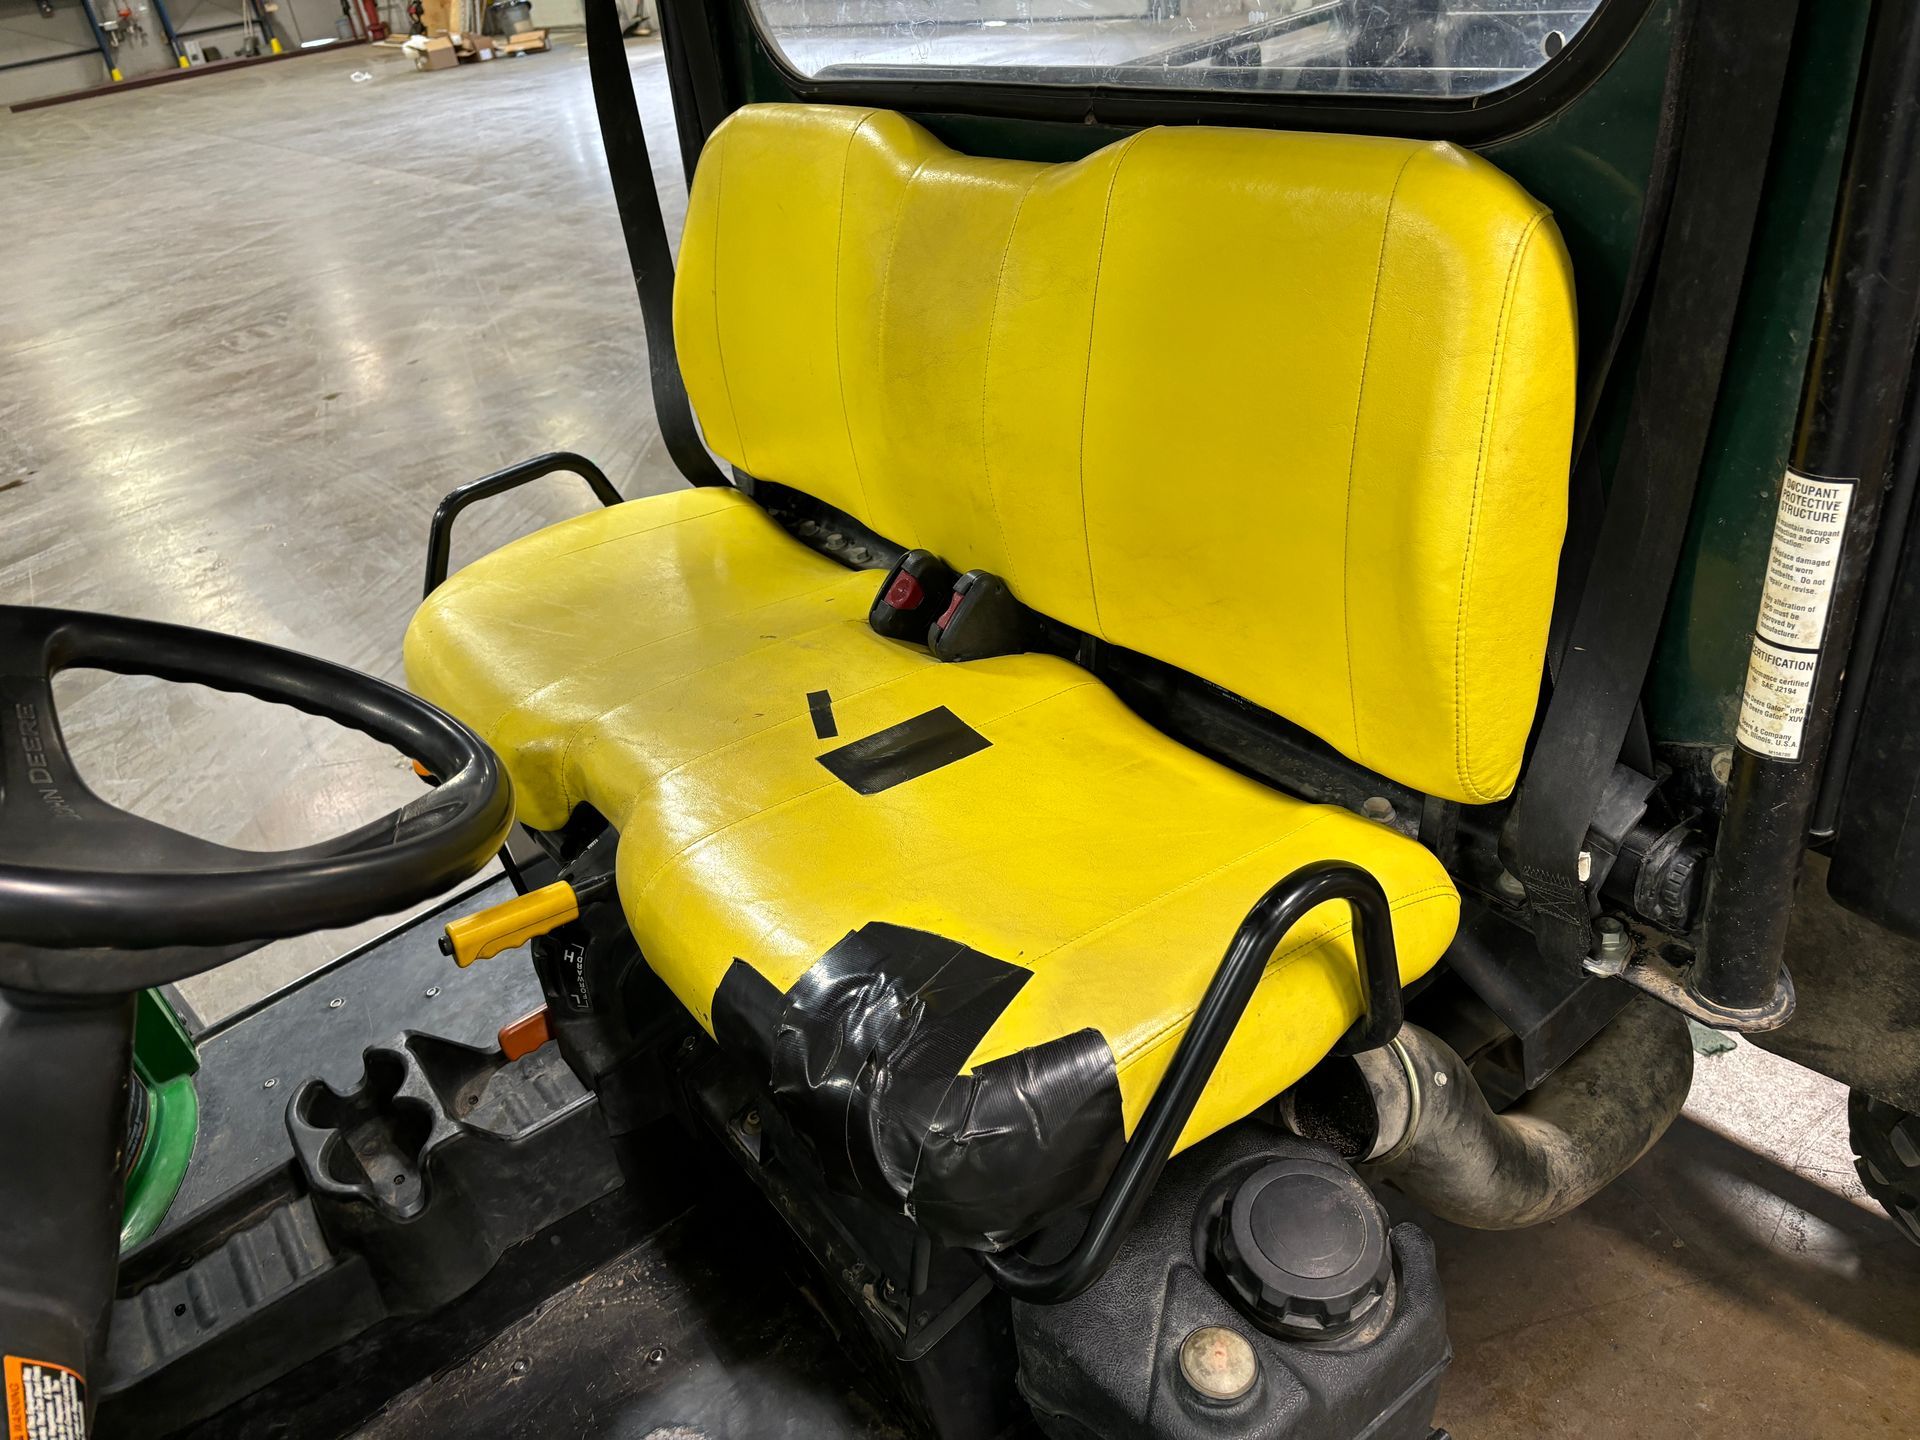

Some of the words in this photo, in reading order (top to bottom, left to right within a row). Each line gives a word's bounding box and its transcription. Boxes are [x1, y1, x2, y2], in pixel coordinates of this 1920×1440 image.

[1786, 478, 1840, 499] OCCUPANT
[1782, 489, 1842, 511] PROTECTIVE
[1780, 501, 1838, 523] STRUCTURE
[1798, 534, 1812, 543] and
[1813, 536, 1830, 545] OPS
[1805, 527, 1840, 538] occupant
[1781, 561, 1793, 571] and
[1795, 567, 1814, 575] worn
[1795, 556, 1831, 568] damaged
[1800, 576, 1811, 585] Do
[1791, 585, 1818, 595] revise.
[1773, 597, 1806, 612] alteration
[1773, 608, 1789, 618] must
[1790, 612, 1800, 621] be
[1786, 620, 1796, 630] by
[1761, 680, 1774, 690] SAE
[1774, 684, 1797, 695] J2194
[1779, 677, 1810, 688] certified
[1750, 693, 1765, 706] Deere
[1789, 706, 1804, 714] HPX
[1748, 701, 1764, 716] Deere
[1788, 714, 1804, 723] XUV
[1760, 728, 1792, 741] Company
[15, 703, 53, 784] DEERE
[563, 949, 575, 963] H
[576, 956, 589, 1000] FORWARD
